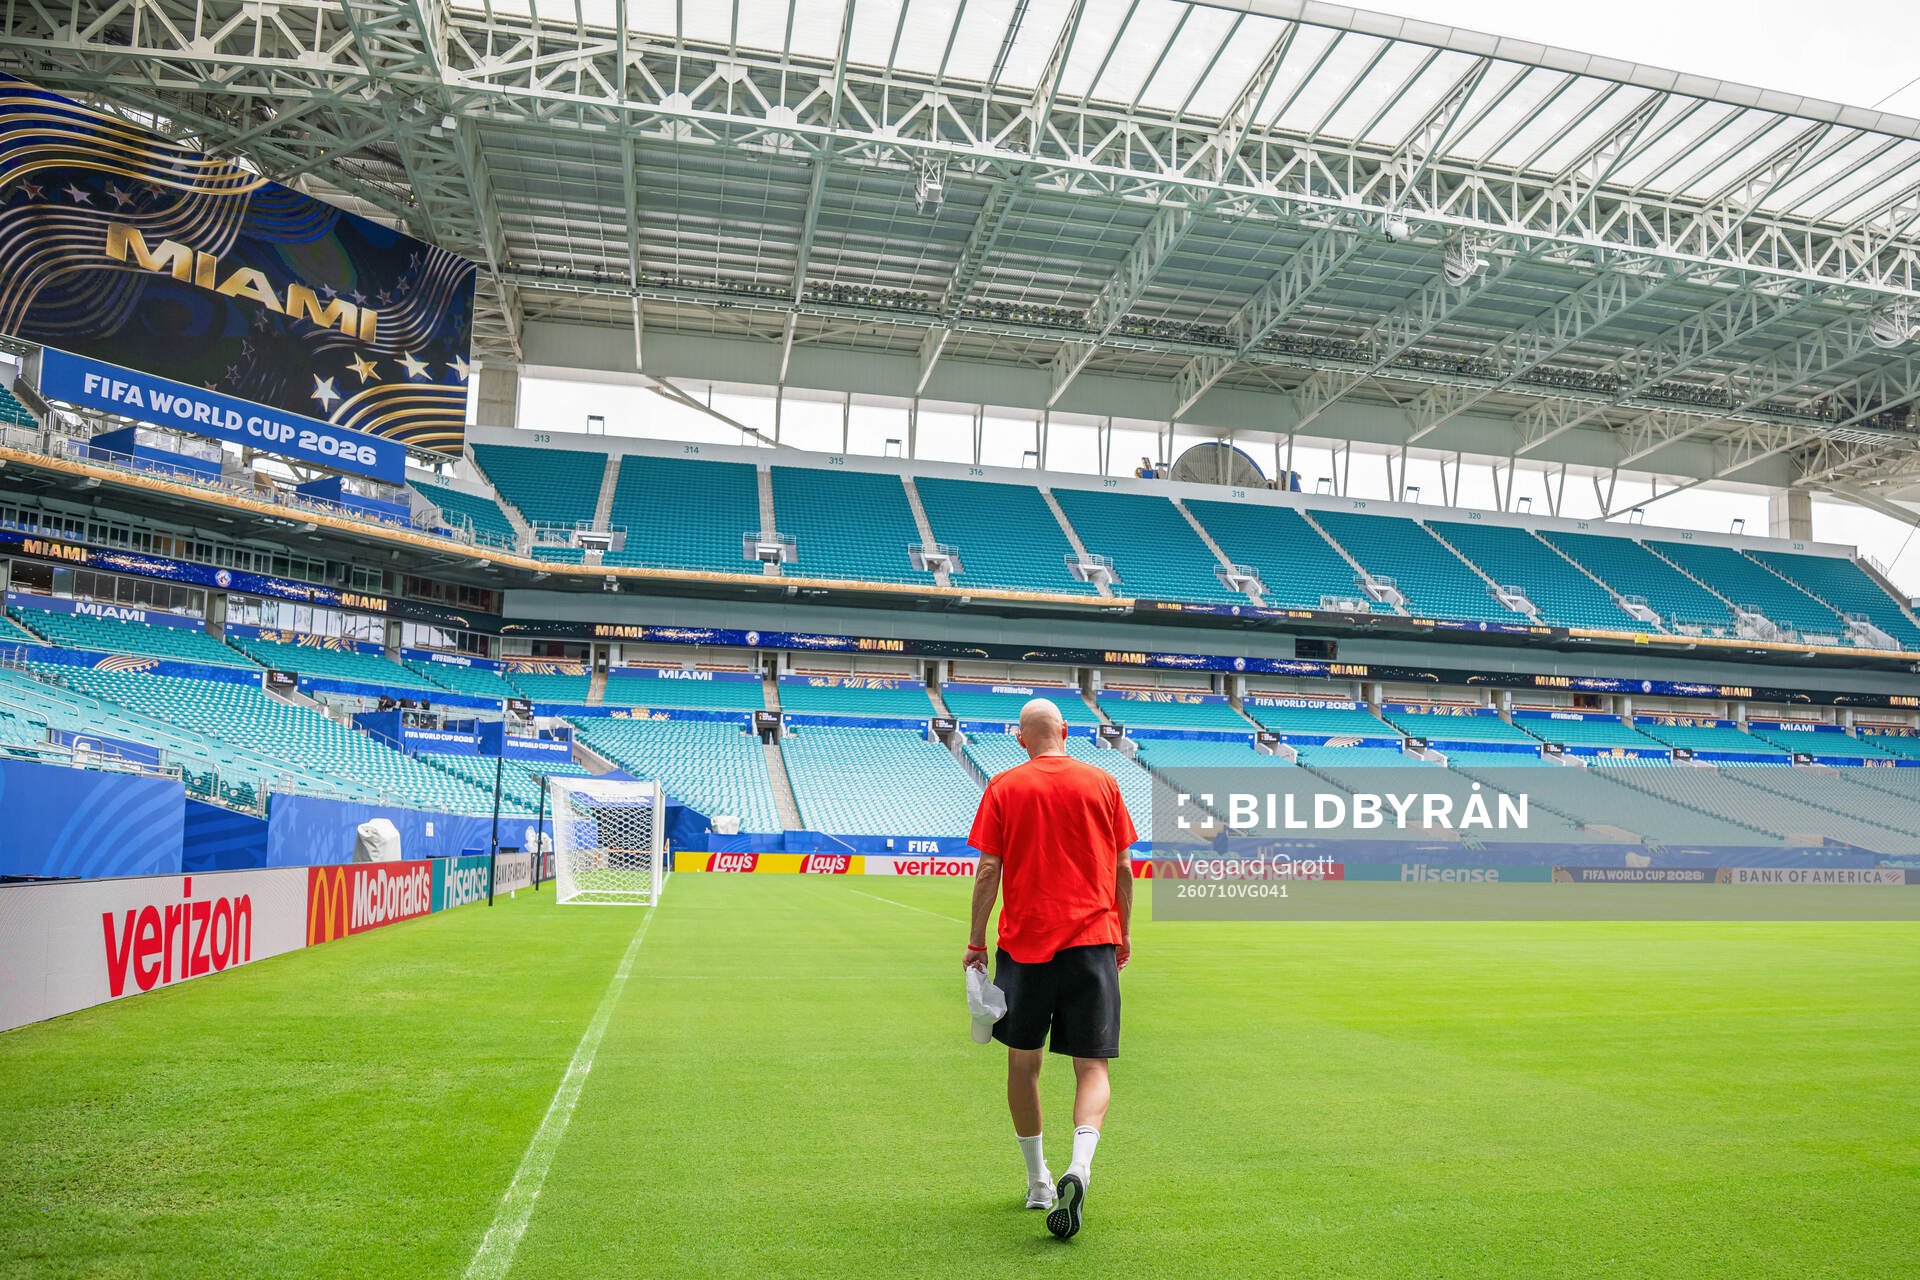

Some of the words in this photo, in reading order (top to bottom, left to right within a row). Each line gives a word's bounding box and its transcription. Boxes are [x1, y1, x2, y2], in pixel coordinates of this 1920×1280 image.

[106, 223, 377, 343] MIAMI
[84, 372, 144, 408] FIFA
[150, 389, 243, 431] WORLD
[247, 416, 296, 443] CUP
[299, 430, 376, 465] 2026
[533, 434, 550, 443] 313
[684, 445, 700, 454] 314
[828, 456, 844, 465] 315
[968, 468, 984, 476] 316
[434, 474, 450, 487] 312
[1103, 479, 1117, 488] 317
[1232, 490, 1245, 498] 318
[1353, 501, 1366, 509] 319
[1468, 512, 1482, 520] 320
[1577, 522, 1589, 530] 321
[1681, 532, 1693, 540] 322
[23, 539, 87, 562] MIAMI
[341, 593, 388, 611] MIAMI
[1157, 602, 1182, 611] MIAMI
[75, 602, 146, 622] MIAMI
[1288, 610, 1312, 619] MIAMI
[1413, 618, 1435, 626] MIAMI
[595, 625, 643, 638] MIAMI
[1530, 626, 1551, 634] MIAMI
[859, 638, 903, 651] MIAMI
[1105, 651, 1146, 664] MIAMI
[658, 669, 713, 681] MIAMI
[1330, 664, 1368, 676] MIAMI
[1535, 676, 1569, 687] MIAMI
[1721, 686, 1752, 697] MIAMI
[1255, 698, 1275, 707] FIFA
[1275, 699, 1307, 708] WORLD
[1308, 700, 1326, 709] CUP
[1326, 701, 1356, 710] 2026
[1890, 696, 1919, 706] MIAMI
[1780, 723, 1815, 732] MIAMI
[419, 732, 440, 740] WORLD
[908, 840, 939, 853] FIFA
[713, 852, 753, 873] Lay's
[806, 854, 846, 874] Lay's
[893, 857, 974, 876] verizon
[1402, 864, 1499, 883] Hisense
[1583, 870, 1604, 880] FIFA
[1606, 870, 1644, 881] WORLD
[1645, 870, 1666, 880] CUP
[1667, 871, 1701, 881] 2026
[1739, 870, 1783, 883] BANK
[1788, 870, 1808, 883] OF
[1812, 870, 1882, 884] AMERICA
[443, 857, 488, 910] Hisense
[352, 866, 431, 930] McDonald's
[102, 877, 252, 998] verizon
